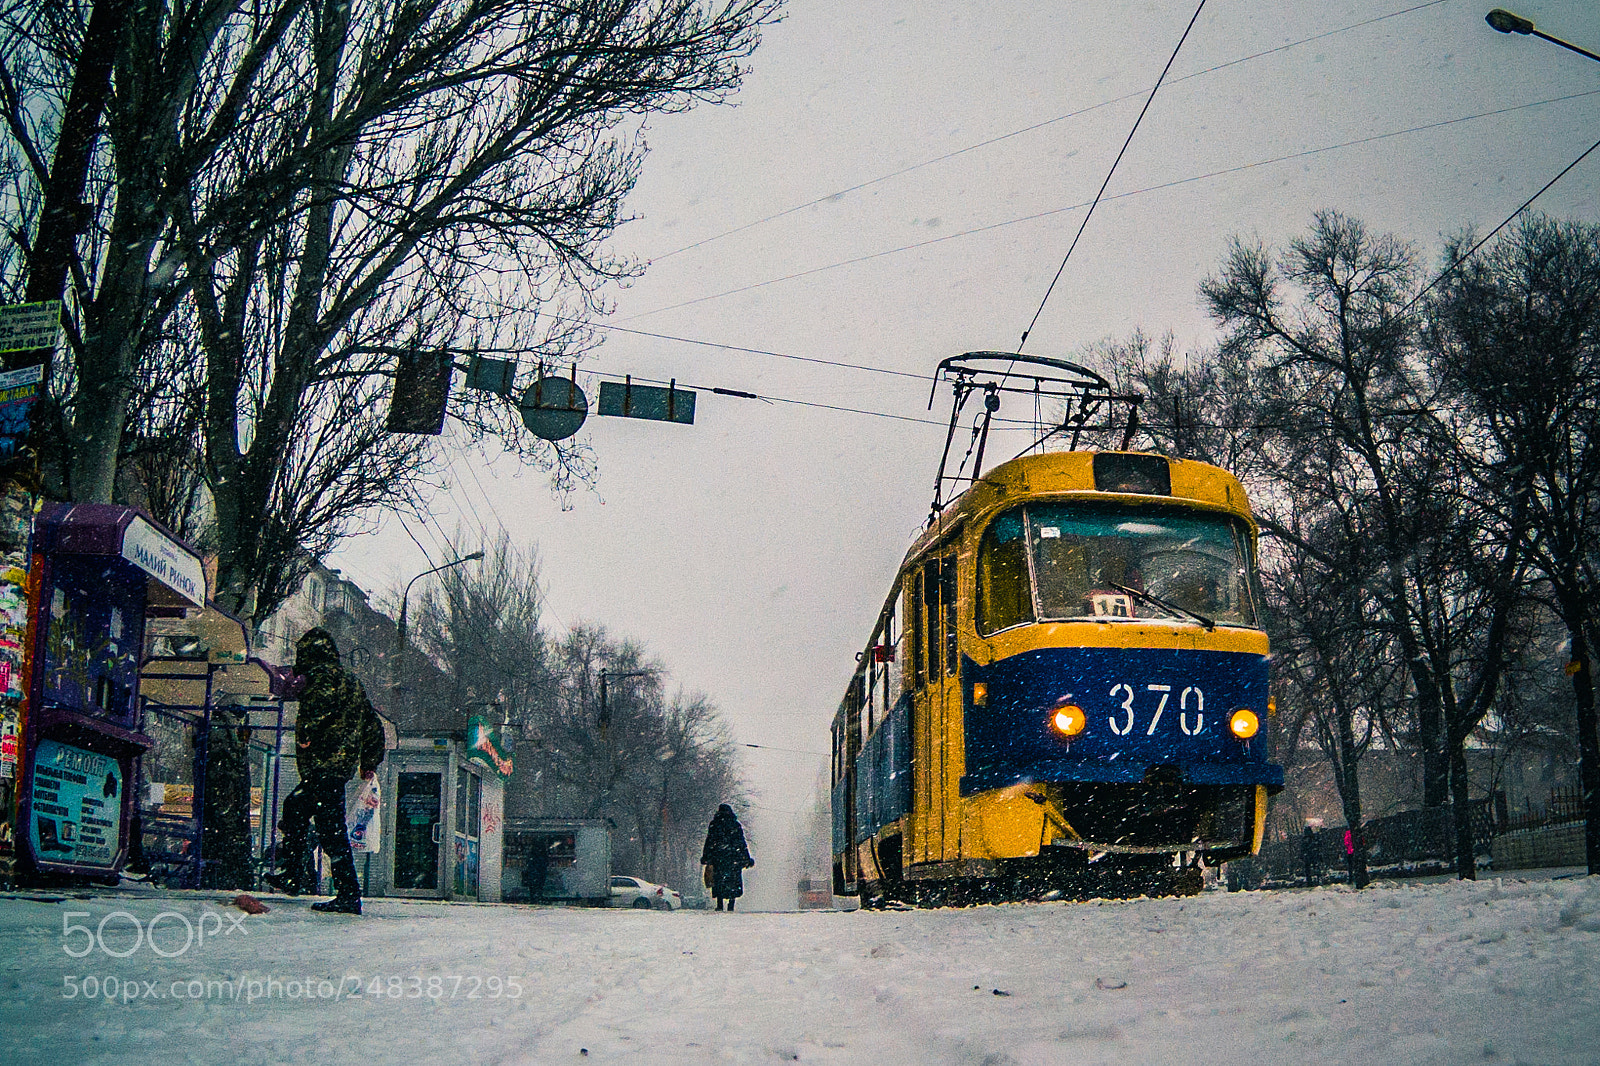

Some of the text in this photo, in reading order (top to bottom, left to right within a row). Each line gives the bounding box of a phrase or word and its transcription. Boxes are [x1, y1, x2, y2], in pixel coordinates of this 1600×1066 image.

[134, 544, 167, 577] МАЛИЙ
[169, 566, 196, 597] РИНОК
[1108, 683, 1205, 737] 370
